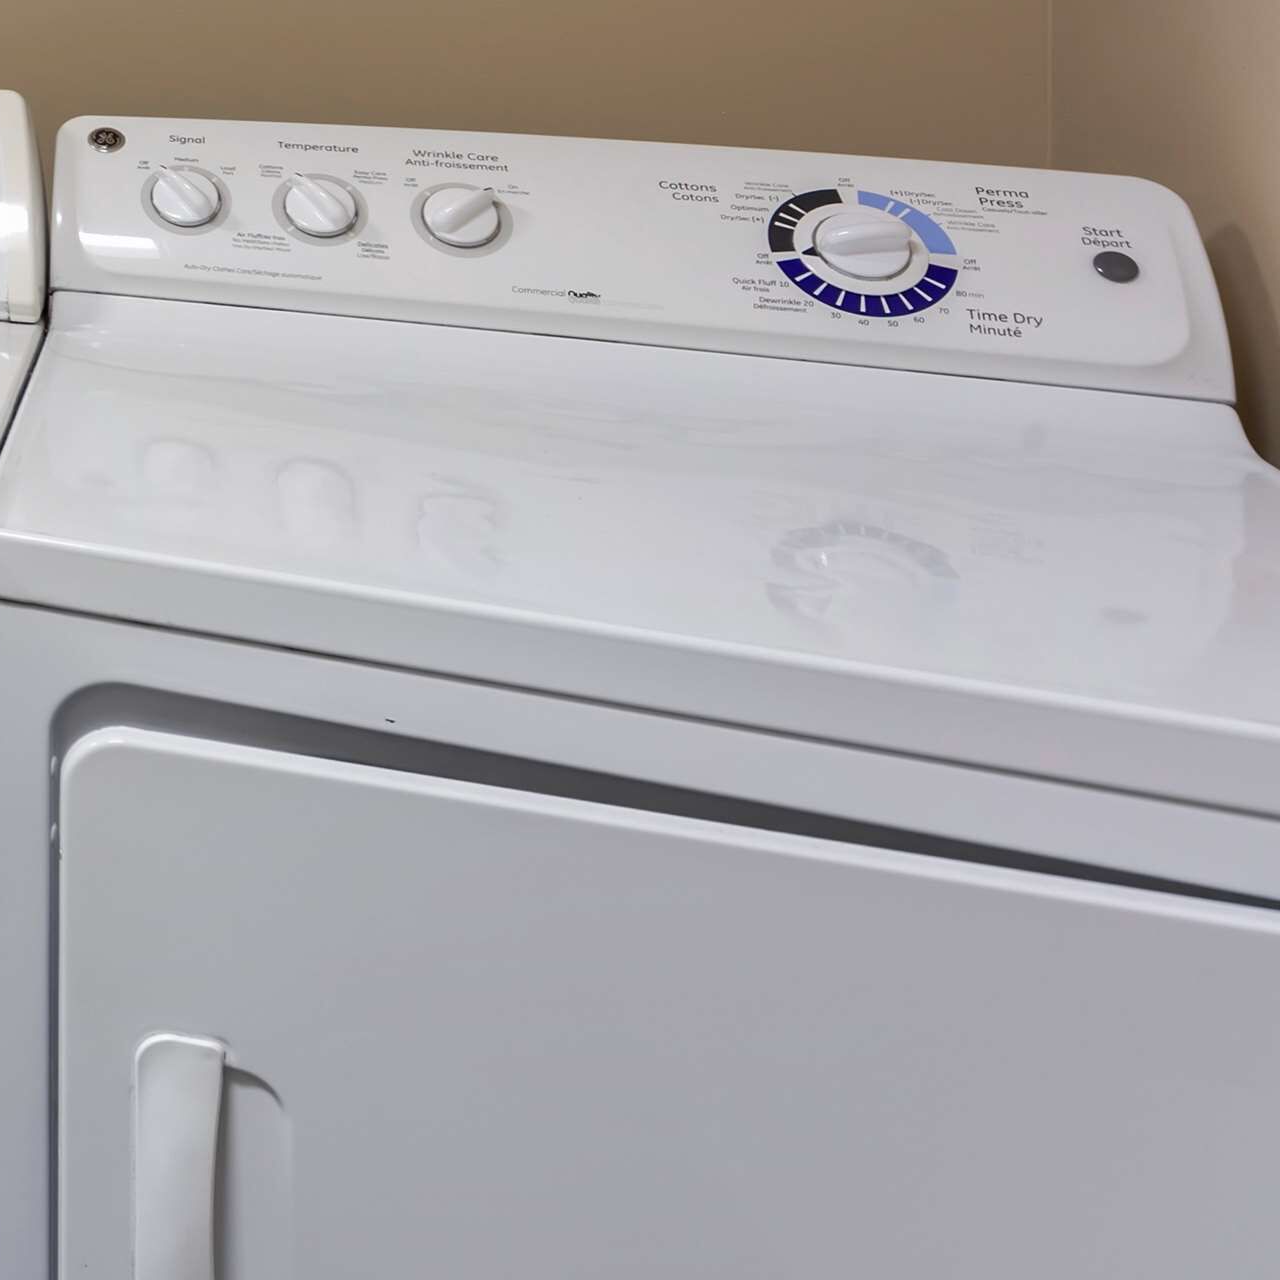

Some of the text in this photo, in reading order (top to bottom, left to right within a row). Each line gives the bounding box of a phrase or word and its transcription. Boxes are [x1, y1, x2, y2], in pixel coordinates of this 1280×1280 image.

[169, 134, 206, 145] Signal
[277, 141, 360, 153] Temperature
[412, 149, 499, 162] Wrinkle Care
[405, 158, 509, 172] Anti-froissement
[658, 180, 717, 193] Cottons
[975, 186, 1029, 199] Perma
[672, 192, 719, 203] Cotons
[979, 197, 1024, 209] Press
[1082, 226, 1124, 238] Start
[1081, 236, 1132, 249] Départ
[732, 277, 756, 286] Quick
[758, 279, 777, 287] Fluff
[511, 285, 566, 297] Commercial
[759, 296, 801, 307] Dewrinkle
[967, 308, 1043, 328] Time Dry
[969, 323, 1023, 338] Minuté
